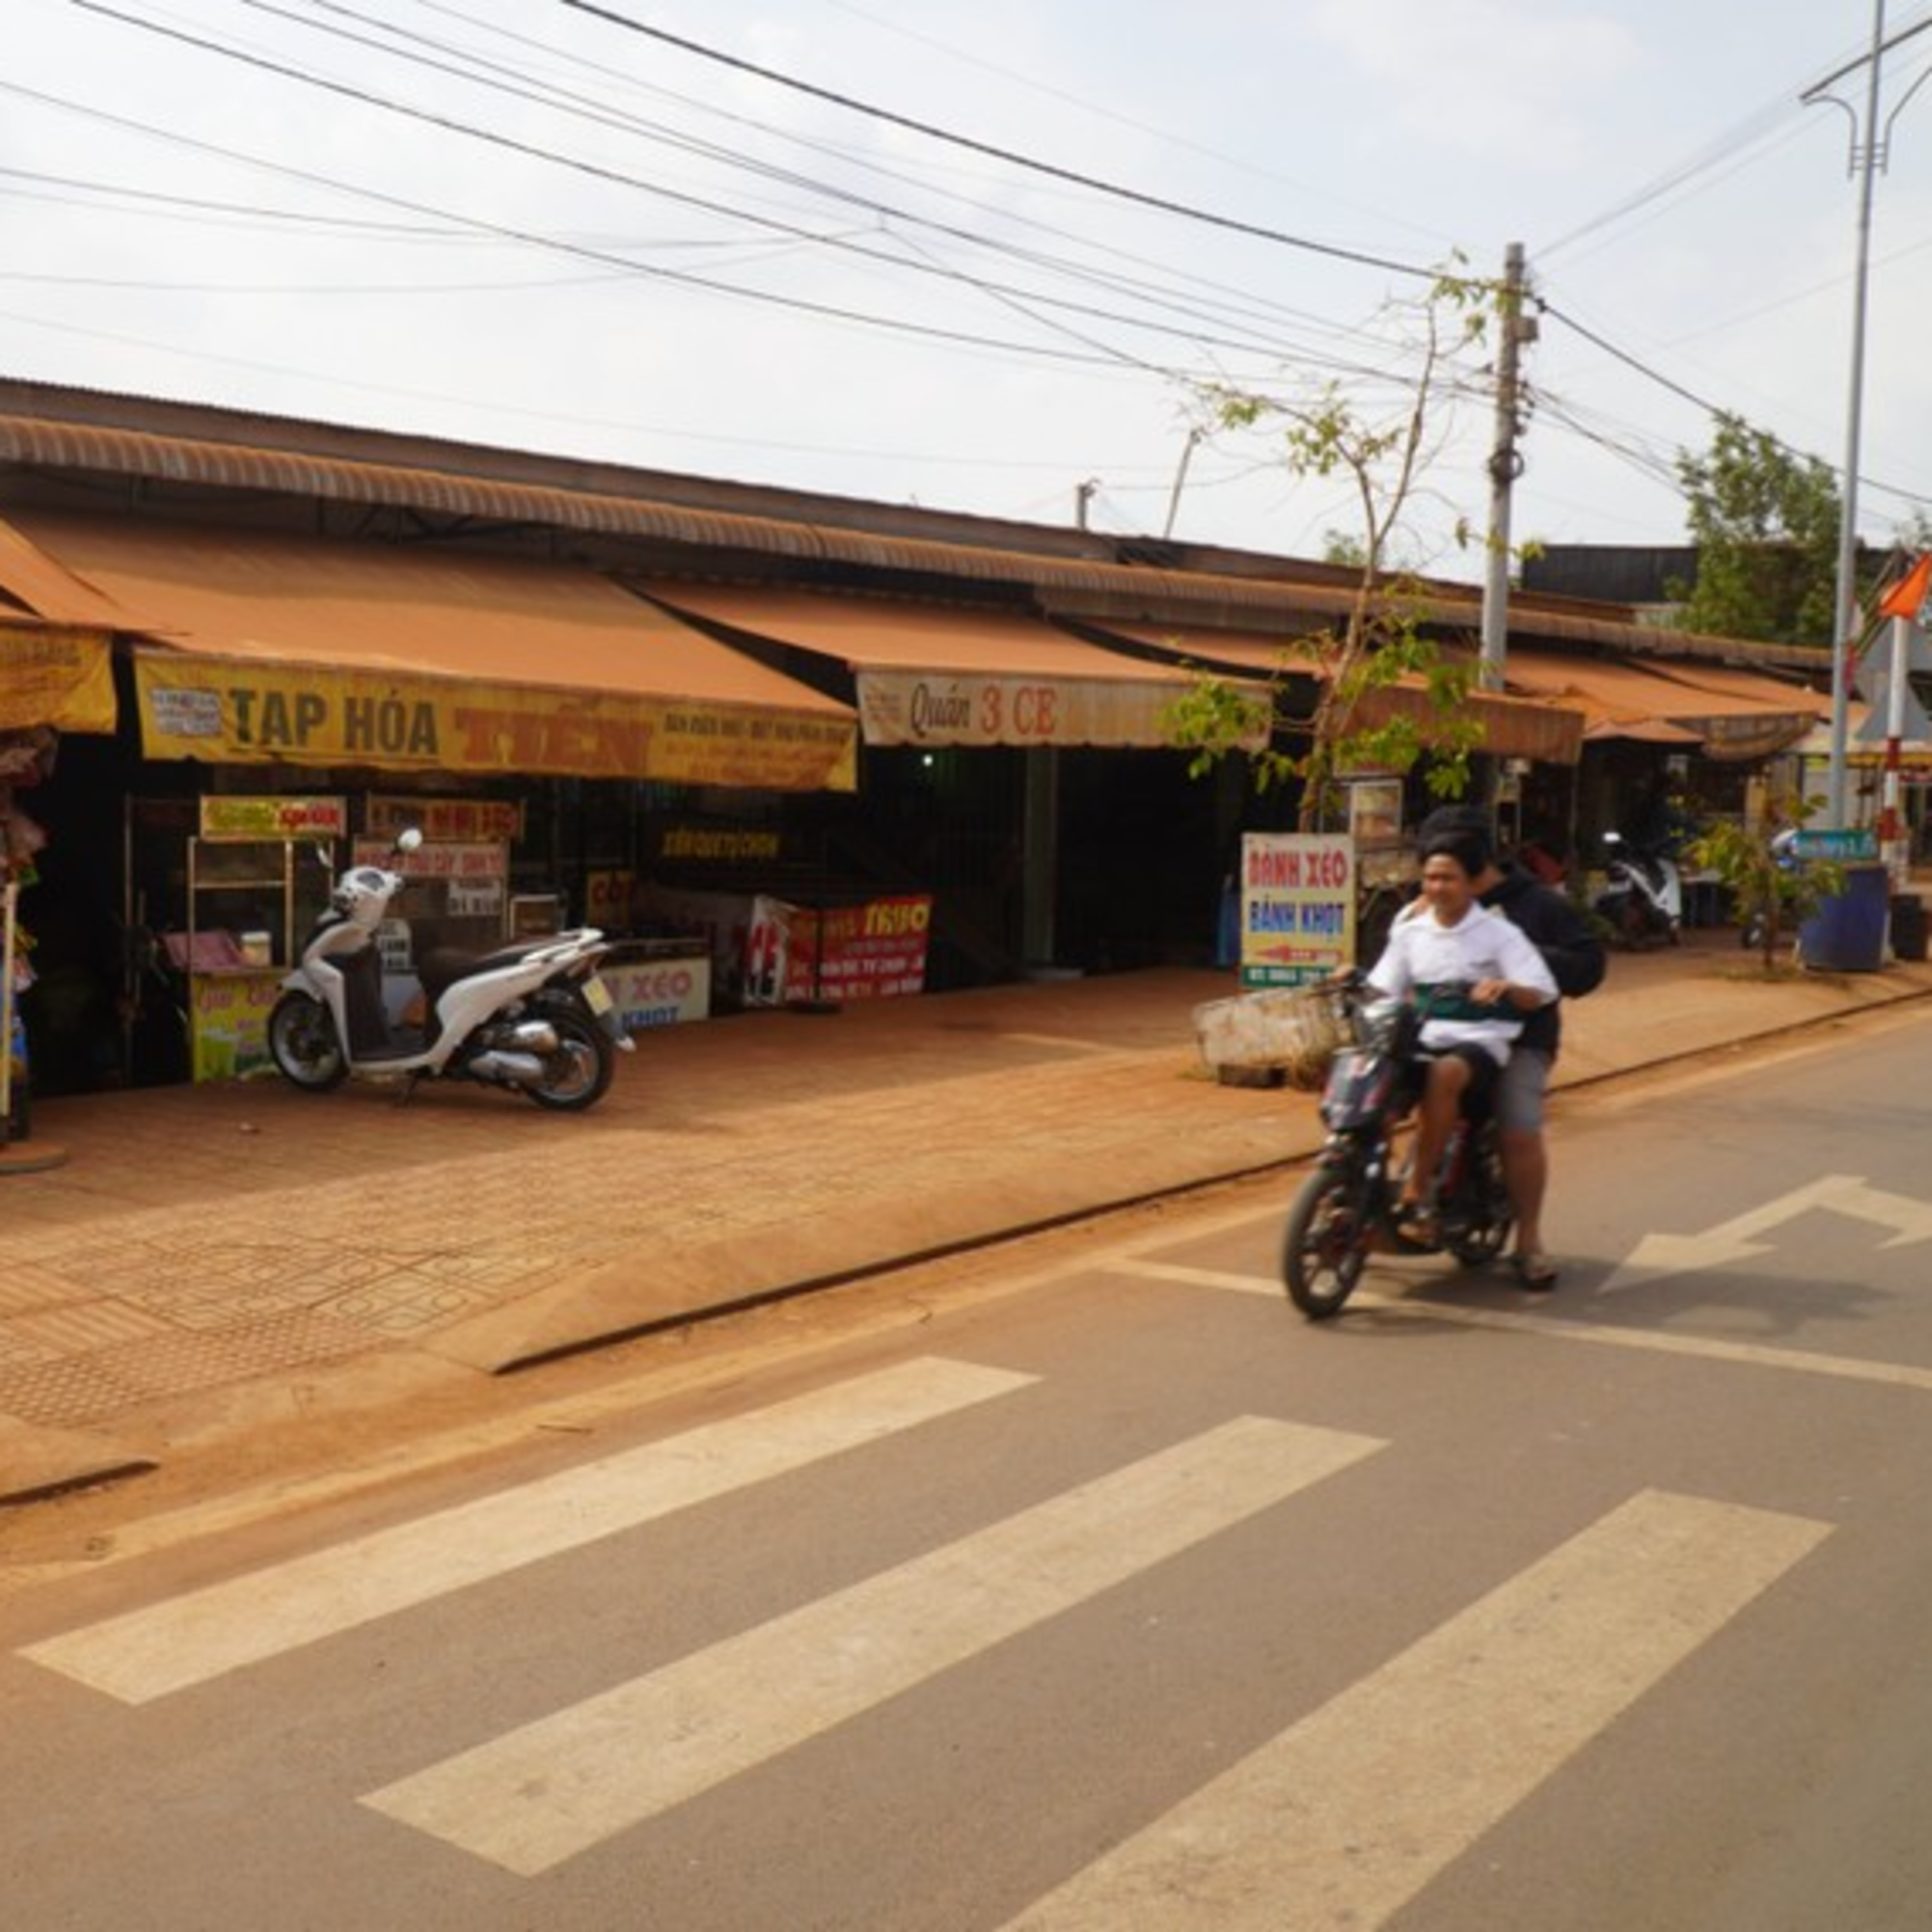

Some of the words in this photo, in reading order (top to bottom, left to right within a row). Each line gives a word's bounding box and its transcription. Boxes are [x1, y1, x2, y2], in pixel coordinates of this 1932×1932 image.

[343, 689, 440, 754] HÓA
[981, 684, 1001, 735] 3
[1249, 893, 1296, 932] BÁNH
